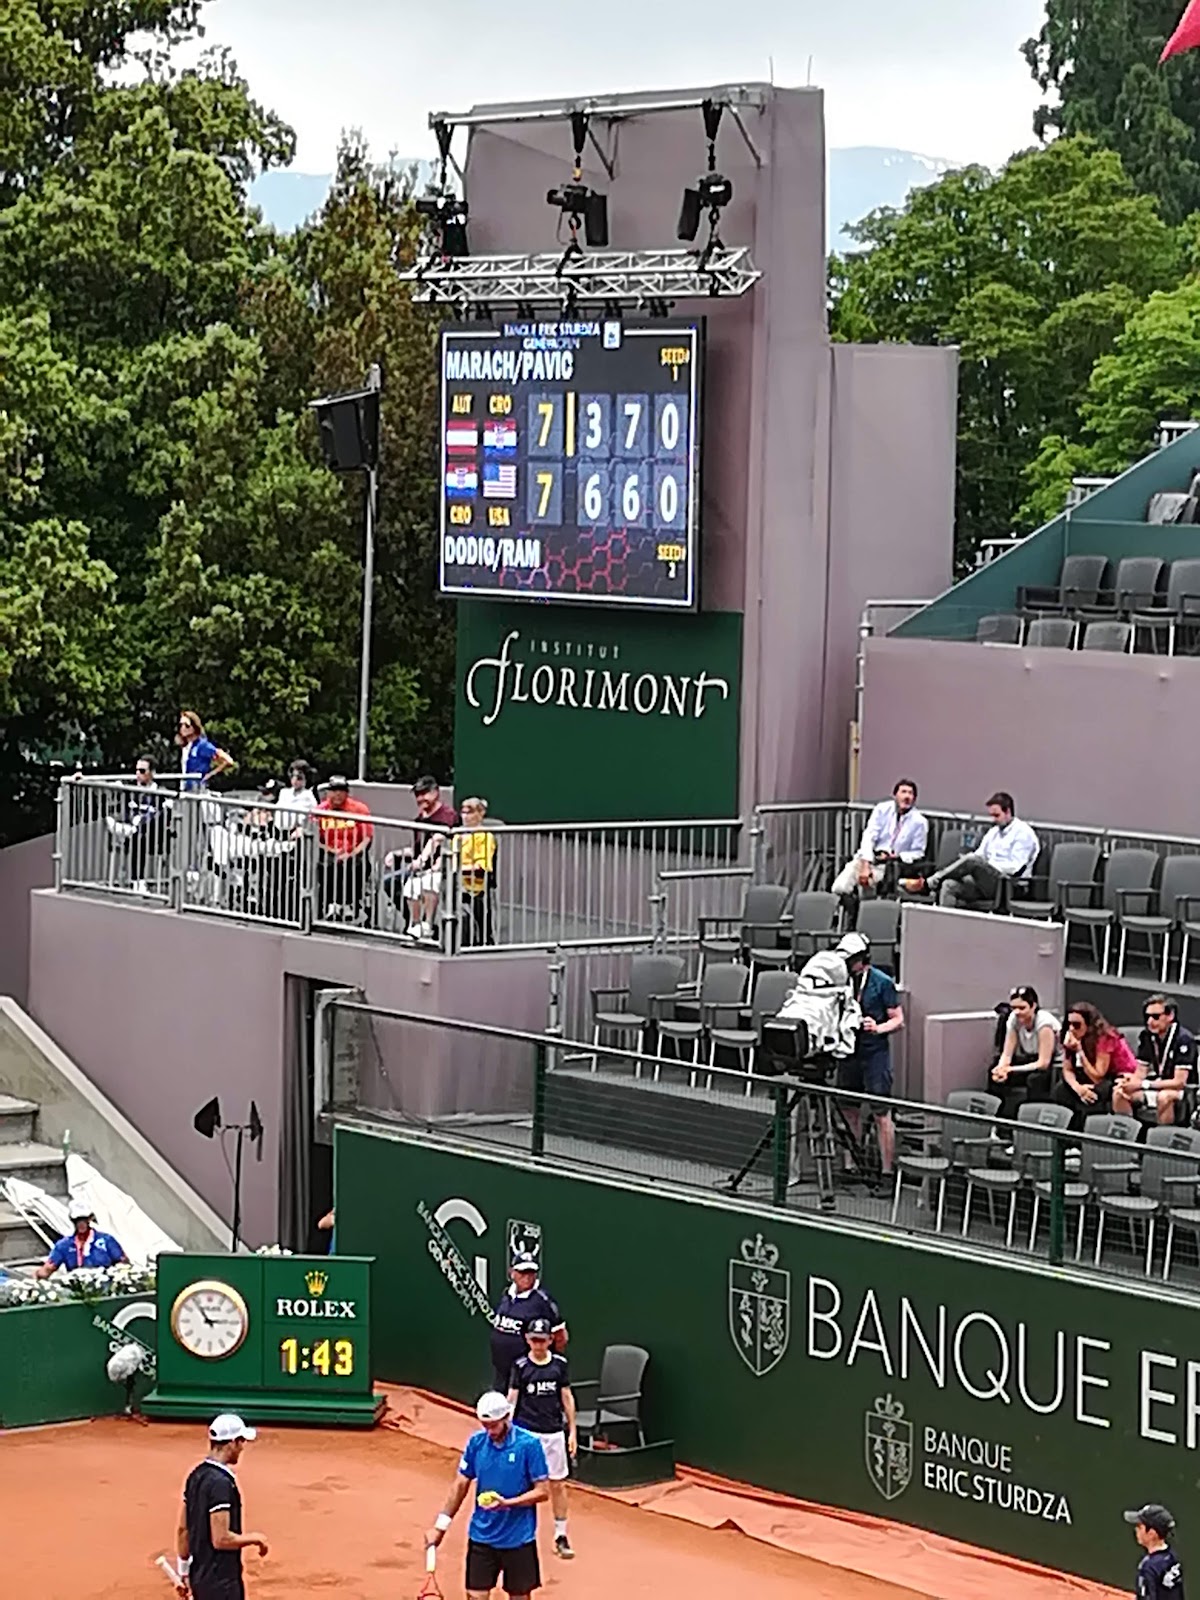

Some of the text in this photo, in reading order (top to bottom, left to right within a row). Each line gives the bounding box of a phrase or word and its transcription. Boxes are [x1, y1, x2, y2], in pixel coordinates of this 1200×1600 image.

[446, 350, 574, 384] MARACH/PAVIC
[452, 394, 511, 414] AUT CRO
[537, 403, 679, 450] 7 3 7 0
[450, 504, 510, 526] CRO USA
[536, 473, 678, 522] 7 6 6 0
[445, 536, 541, 572] DODIG/RAM
[530, 639, 620, 659] INSTITUT
[276, 1298, 356, 1318] ROLEX
[280, 1339, 353, 1376] 1:43
[808, 1275, 1111, 1428] BANQUE
[924, 1426, 1012, 1473] BANQUE
[924, 1462, 1072, 1524] ERIC STURDZA
